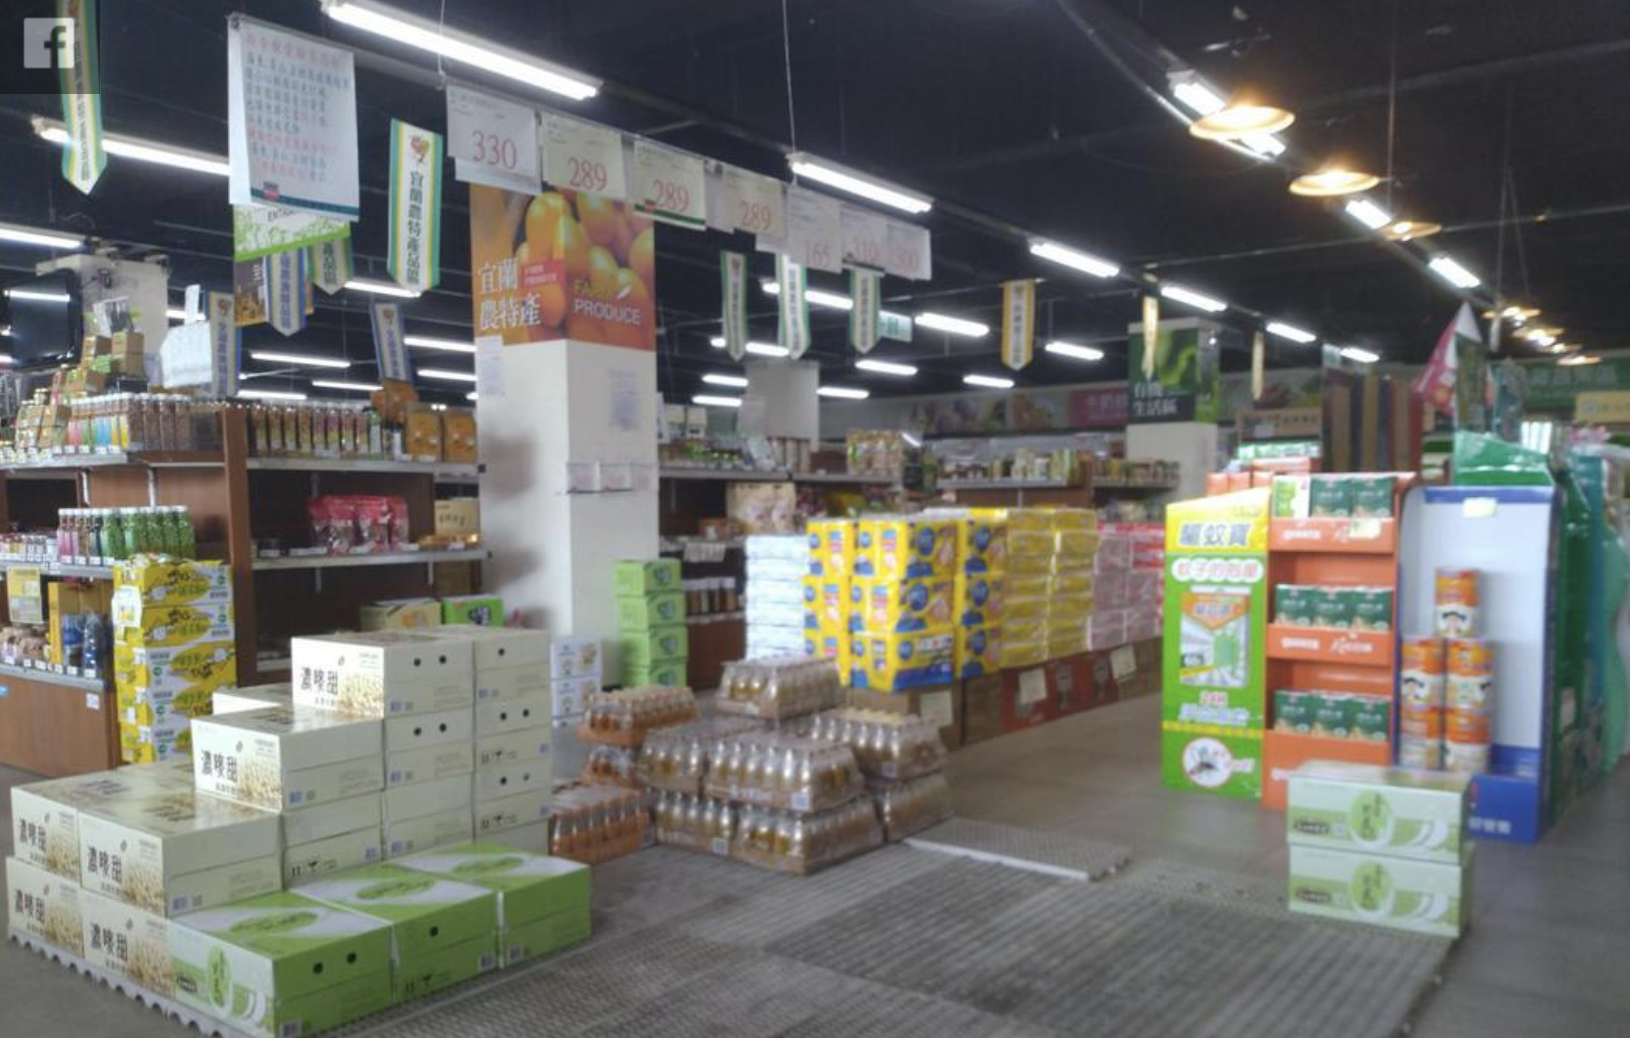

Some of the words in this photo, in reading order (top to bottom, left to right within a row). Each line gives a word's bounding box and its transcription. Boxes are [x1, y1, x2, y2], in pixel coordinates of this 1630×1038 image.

[472, 129, 517, 170] 330
[567, 156, 607, 191] 289
[652, 179, 691, 213] 289
[740, 201, 771, 231] 289
[806, 240, 832, 267] 165
[479, 257, 519, 293] 宜蘭
[479, 291, 542, 330] 農特產
[573, 298, 642, 325] PRODUCE
